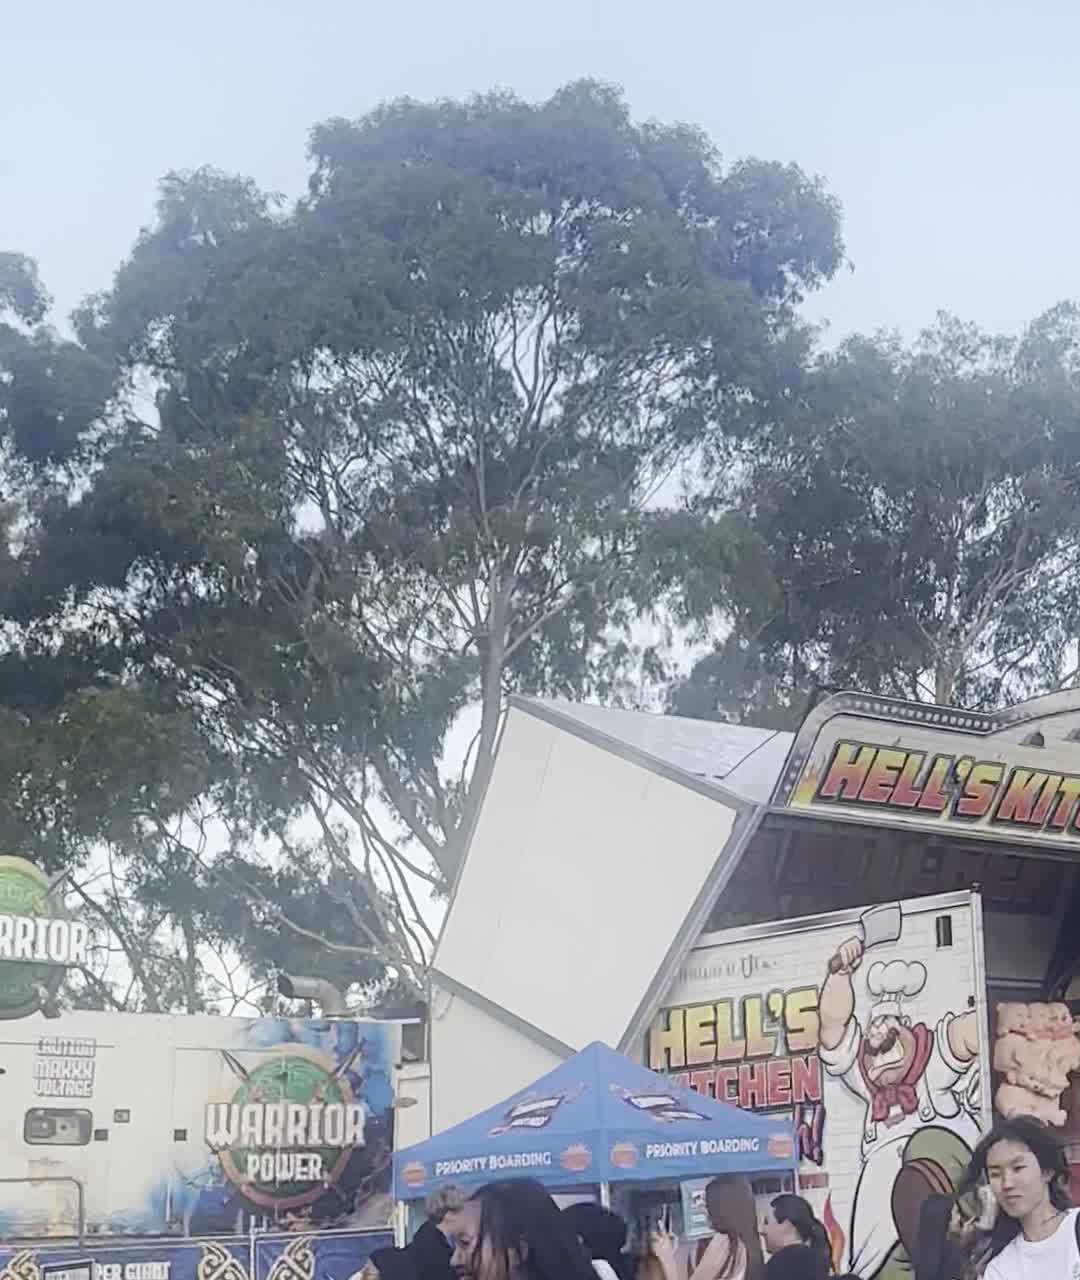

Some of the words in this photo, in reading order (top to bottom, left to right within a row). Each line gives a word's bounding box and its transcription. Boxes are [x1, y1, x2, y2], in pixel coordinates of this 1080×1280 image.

[812, 739, 1006, 822] HELL'S
[0, 913, 88, 964] RRIOR
[650, 984, 820, 1071] HELL'S
[671, 1054, 824, 1113] TCHEN
[205, 1102, 366, 1151] WARRIOR
[645, 1141, 697, 1159] PRIORITY
[700, 1136, 760, 1155] BOARDING
[247, 1152, 323, 1182] POWER
[435, 1156, 487, 1176] PRIORITY
[489, 1151, 552, 1170] BOARDING
